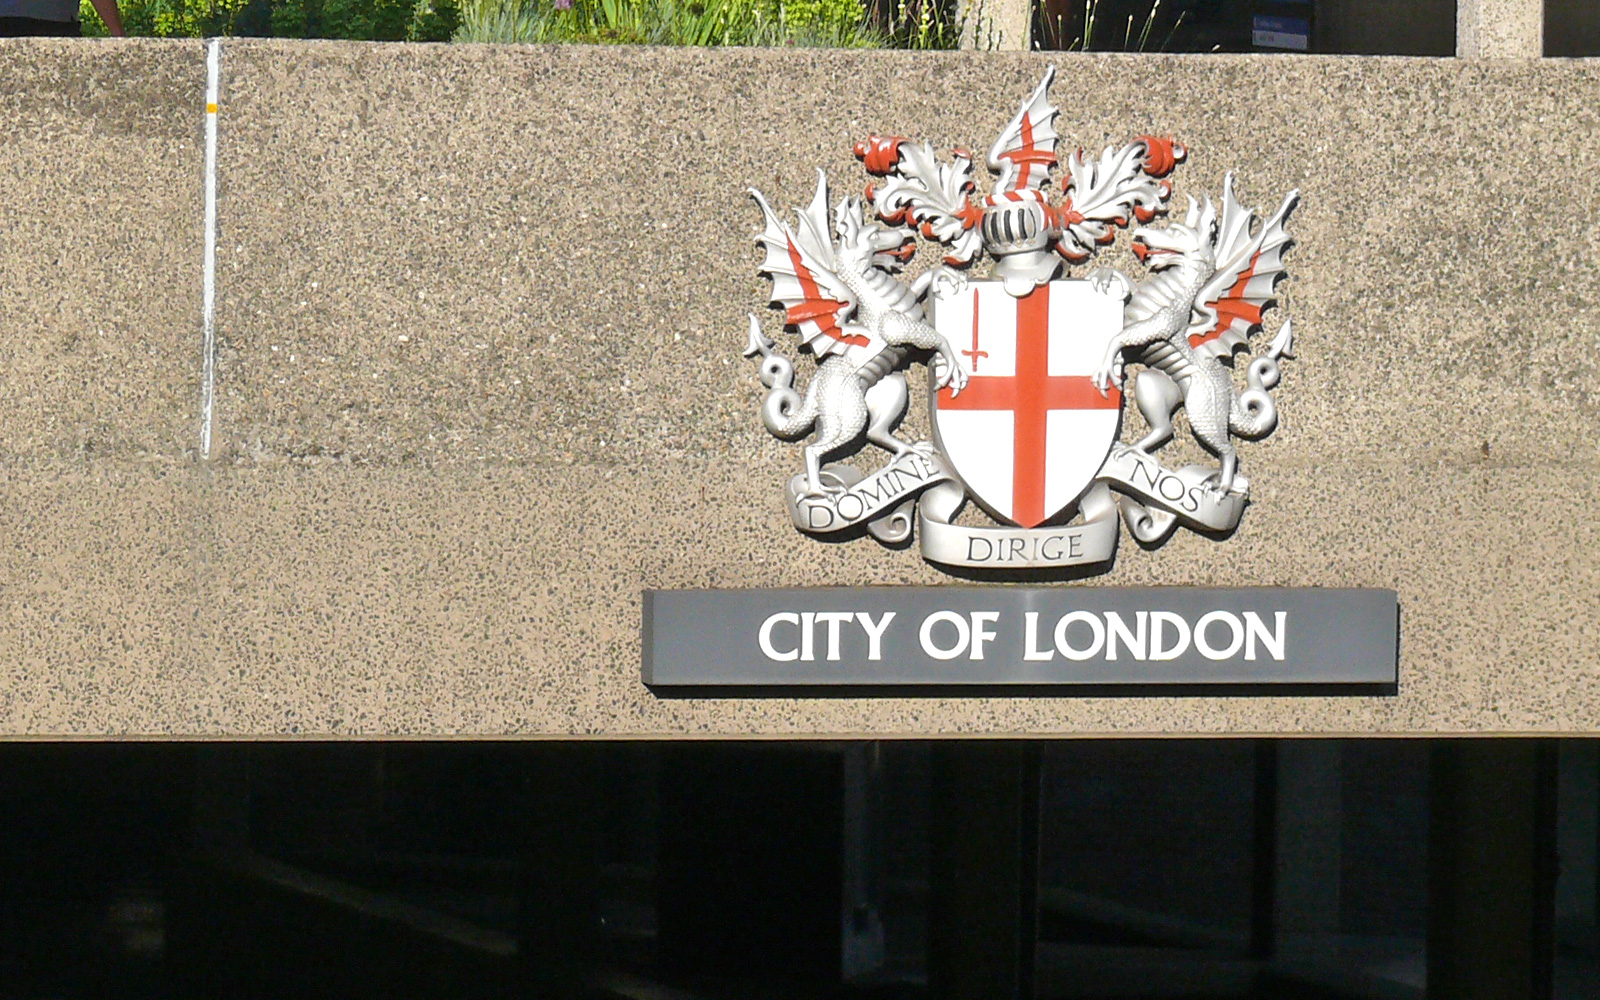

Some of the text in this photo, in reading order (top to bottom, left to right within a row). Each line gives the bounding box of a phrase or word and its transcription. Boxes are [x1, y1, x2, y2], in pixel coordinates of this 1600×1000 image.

[1130, 457, 1203, 512] NOS
[966, 533, 1084, 562] DIRIGE
[758, 610, 1287, 662] CITY OF LONDON
